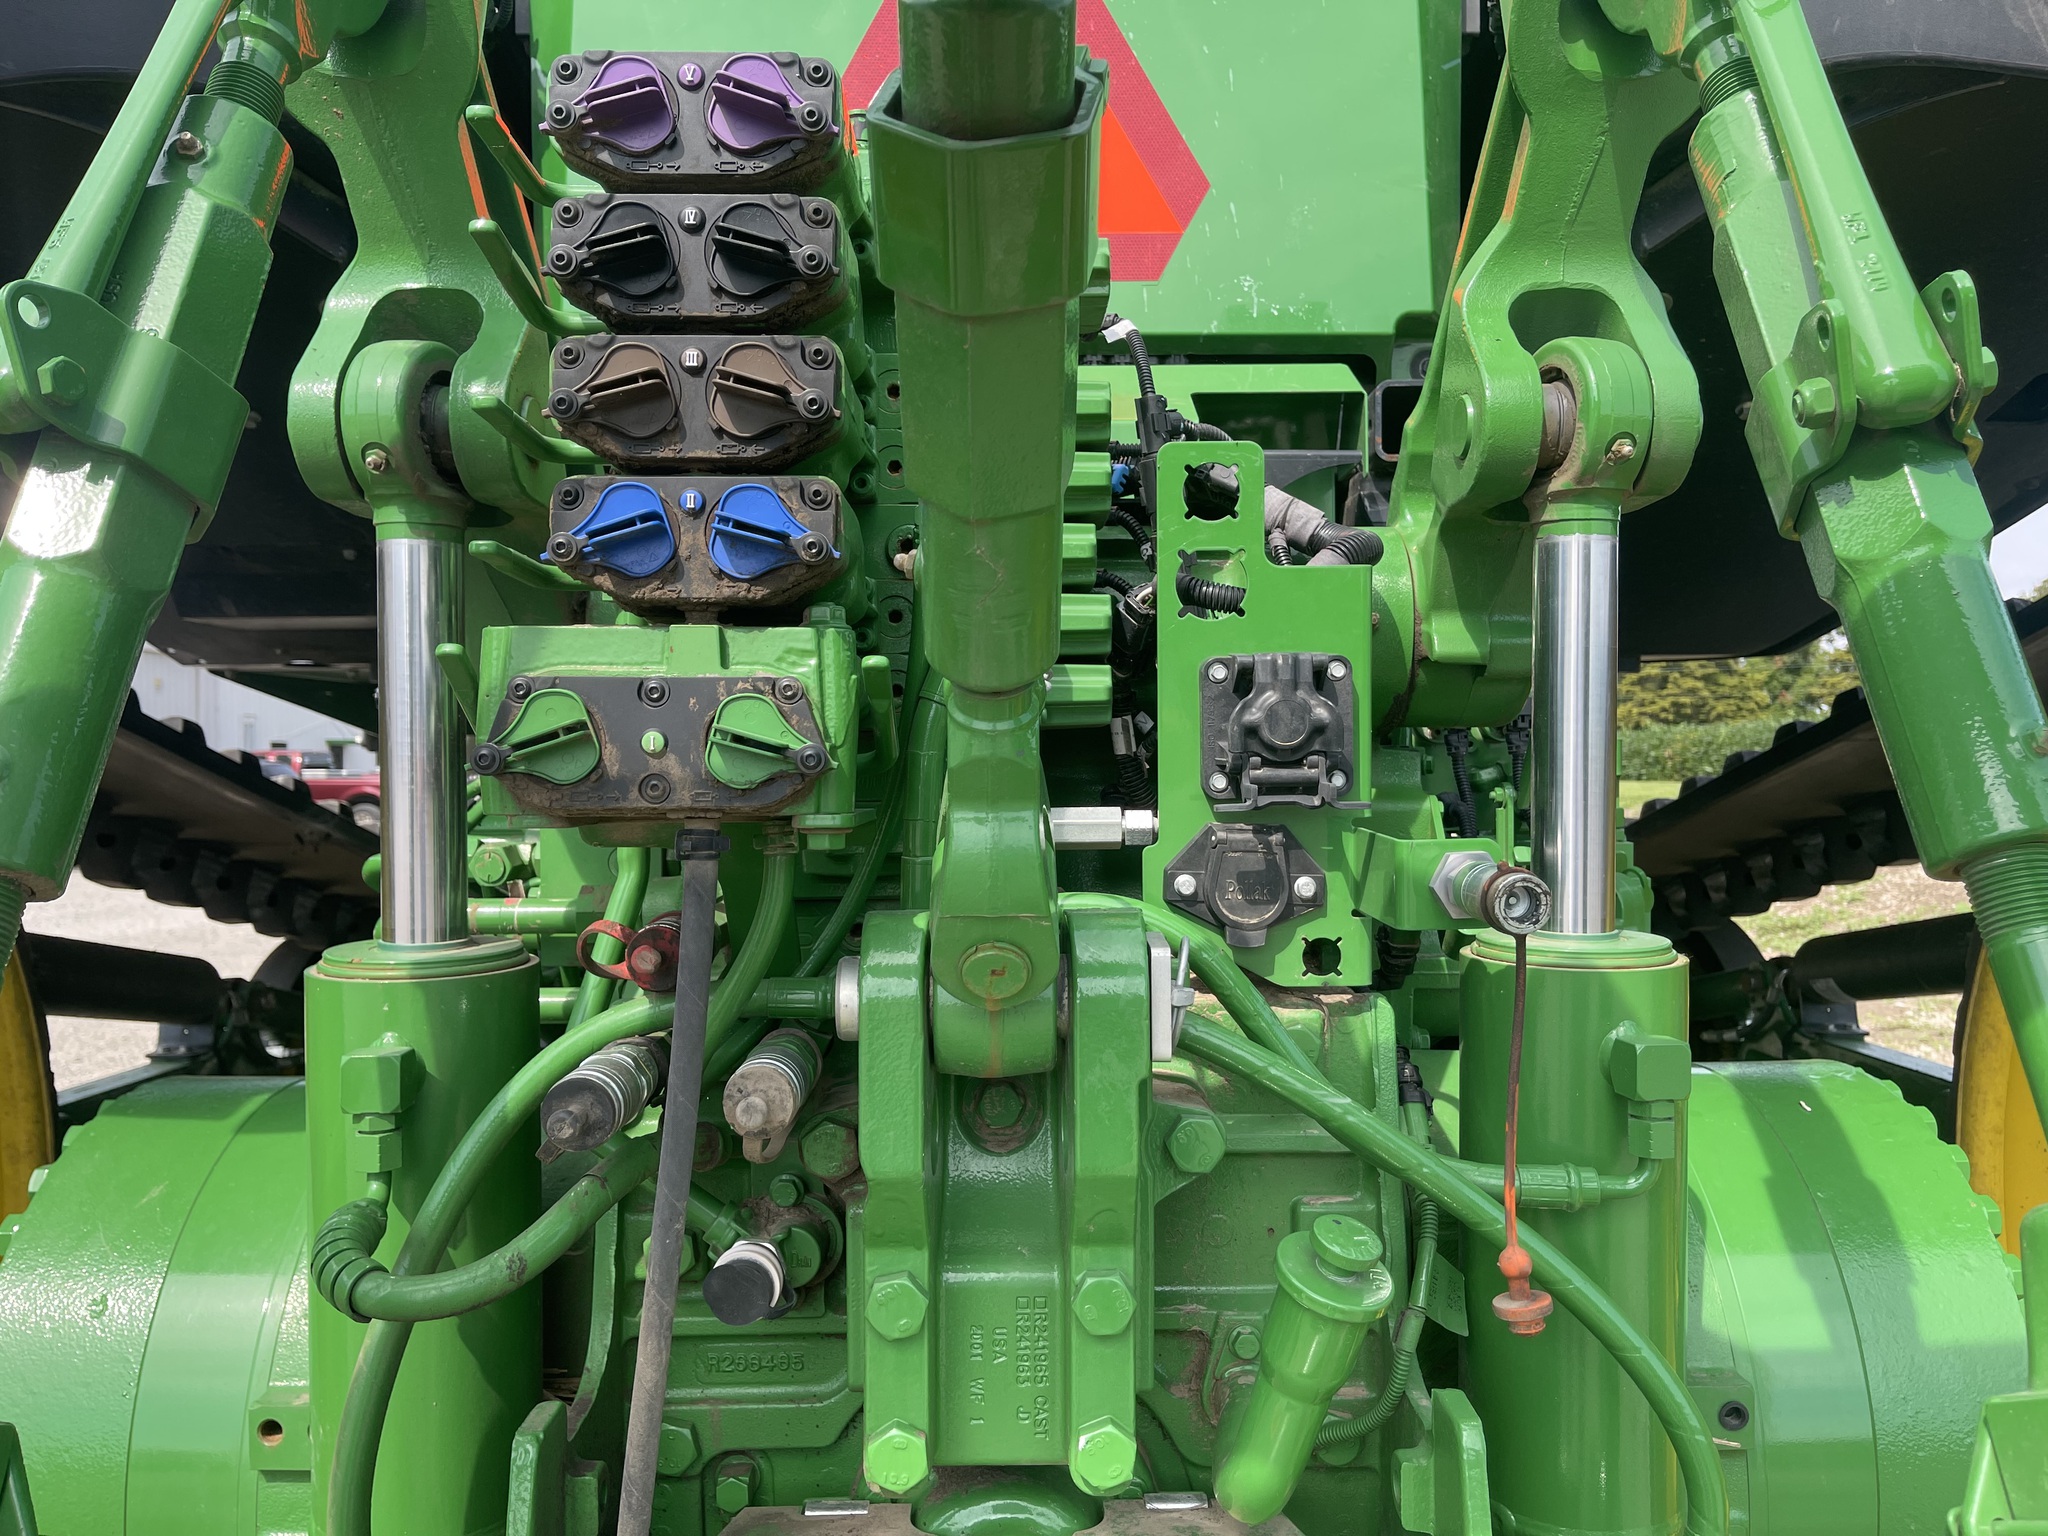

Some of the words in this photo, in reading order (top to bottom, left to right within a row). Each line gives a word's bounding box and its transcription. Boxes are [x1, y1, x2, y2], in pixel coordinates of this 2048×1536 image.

[684, 65, 697, 80] V
[684, 209, 696, 225] IV
[685, 351, 698, 367] III
[686, 493, 695, 509] II
[1225, 879, 1271, 900] Pollak
[992, 1326, 1008, 1364] USA
[1015, 1312, 1031, 1388] R241963
[1033, 1312, 1050, 1388] R241965
[1033, 1395, 1050, 1441] CAST
